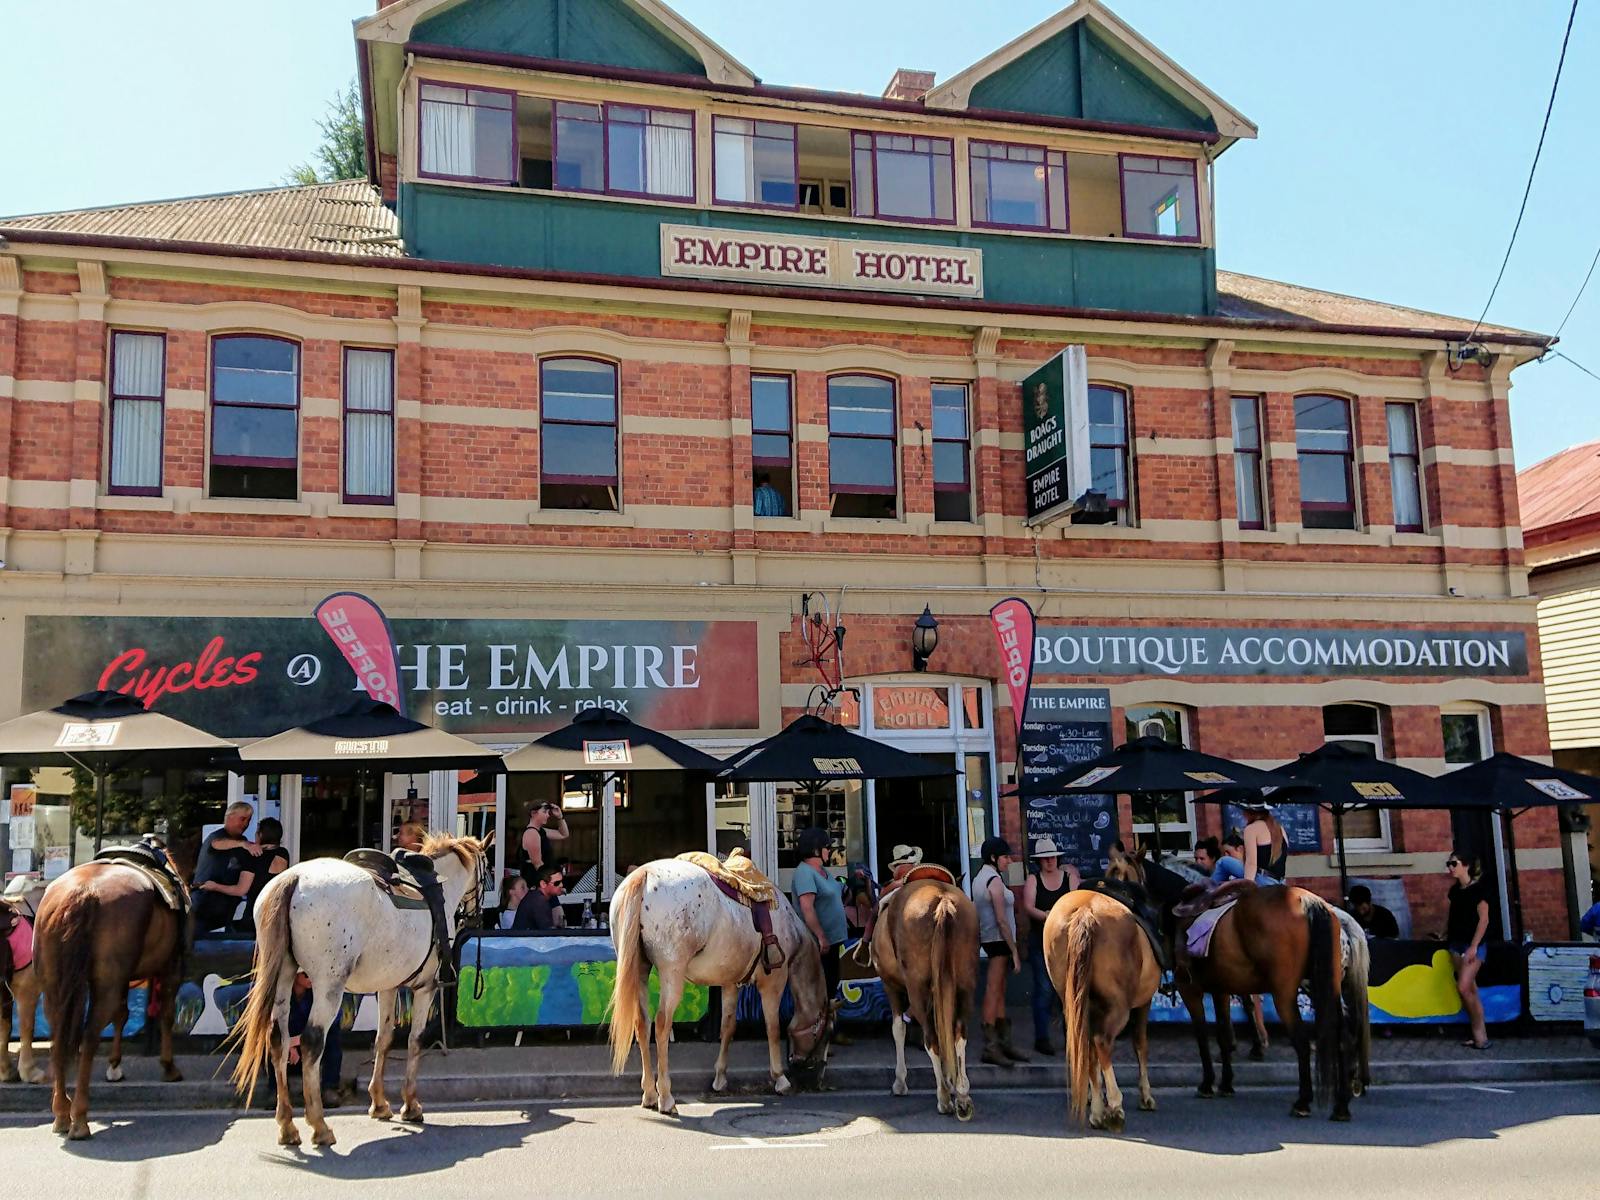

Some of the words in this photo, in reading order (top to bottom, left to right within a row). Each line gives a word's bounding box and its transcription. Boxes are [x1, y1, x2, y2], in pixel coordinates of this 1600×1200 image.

[673, 236, 827, 275] EMPIRE
[854, 250, 974, 286] HOTEL
[1030, 415, 1056, 444] BOAG'S
[1026, 429, 1063, 463] DRAUGHT
[1032, 466, 1060, 494] EMPIRE
[1034, 485, 1060, 510] HOTEL
[352, 644, 470, 691] HE
[487, 643, 701, 691] EMPIRE
[1034, 636, 1208, 674] BOUTIQUE
[1219, 637, 1509, 667] ACCOMMODATION
[97, 635, 262, 710] Cycles
[434, 697, 473, 716] eat
[495, 696, 552, 716] drink
[575, 695, 629, 713] relax
[879, 690, 944, 712] EMPIRE
[1031, 697, 1056, 709] THE
[1060, 697, 1106, 709] EMPIRE
[884, 712, 937, 726] HOTEL
[1023, 744, 1048, 754] Tuesday:
[1024, 766, 1058, 776] Wednesday:
[1026, 810, 1046, 819] Friday:
